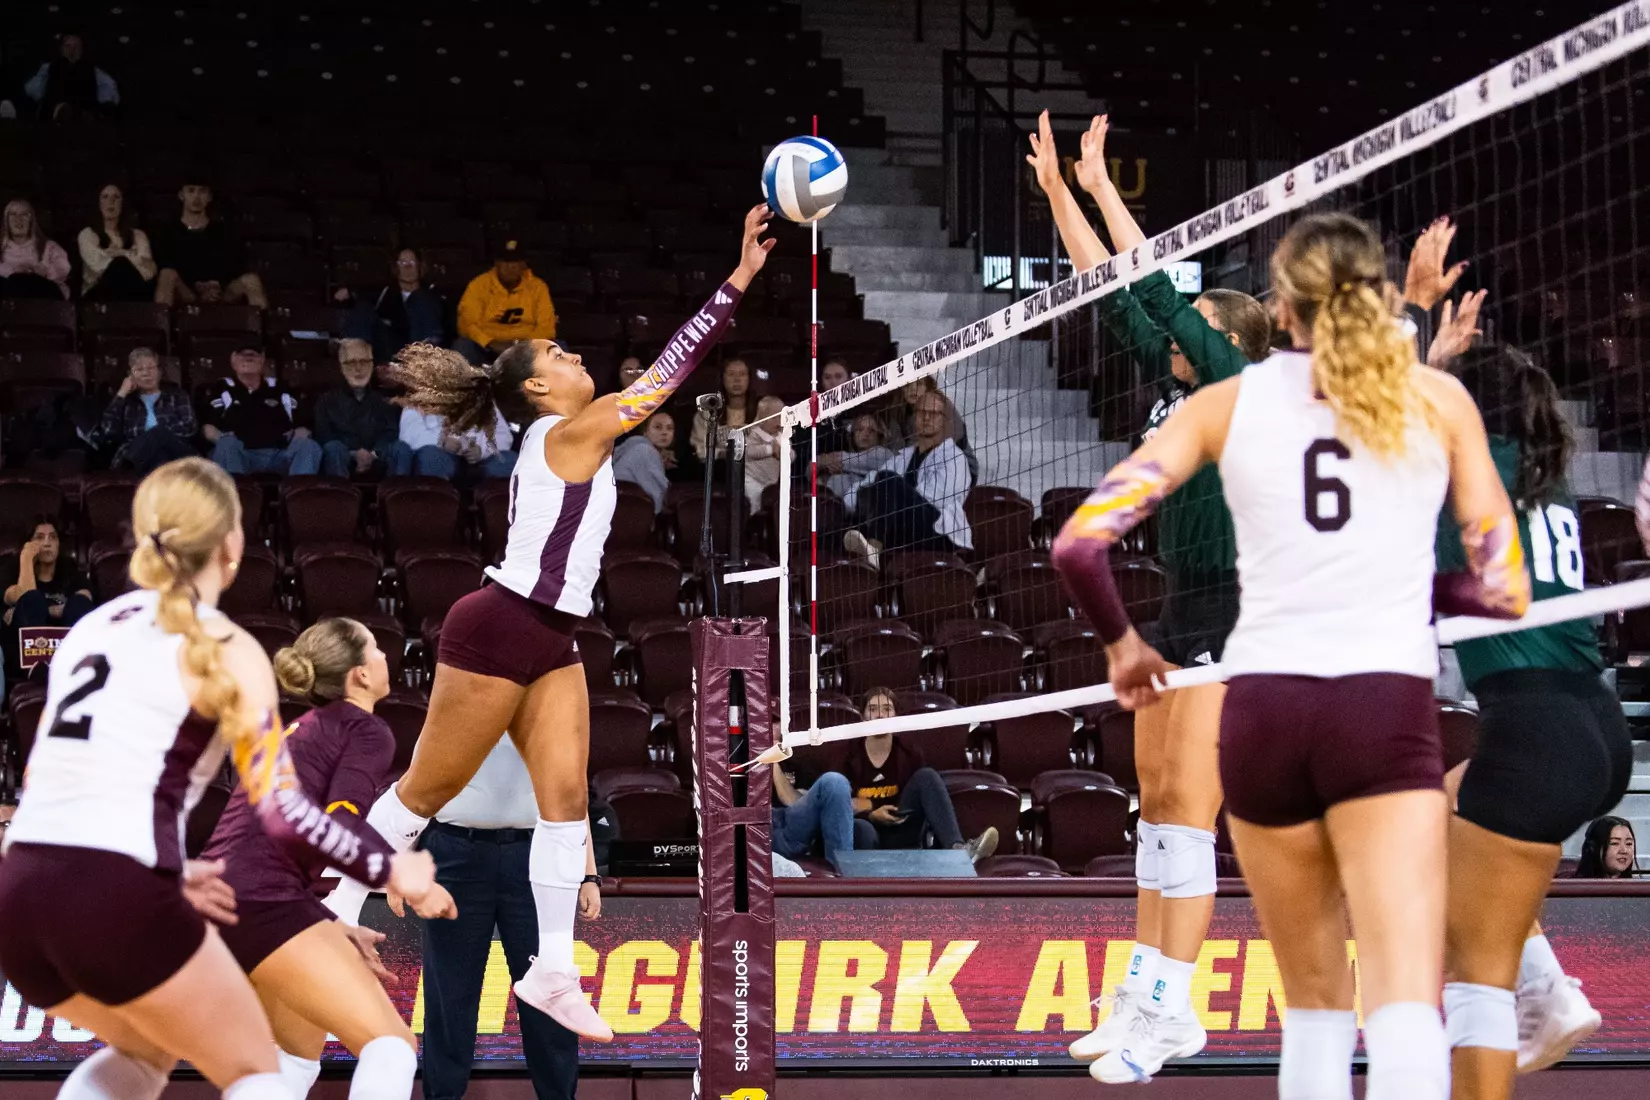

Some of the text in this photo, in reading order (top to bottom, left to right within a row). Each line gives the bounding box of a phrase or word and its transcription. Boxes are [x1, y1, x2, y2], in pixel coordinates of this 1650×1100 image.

[648, 308, 718, 390] CHIPPEWAS
[1303, 437, 1352, 532] 6
[1527, 502, 1585, 591] 18
[47, 654, 111, 740] 2
[732, 940, 750, 997] sports
